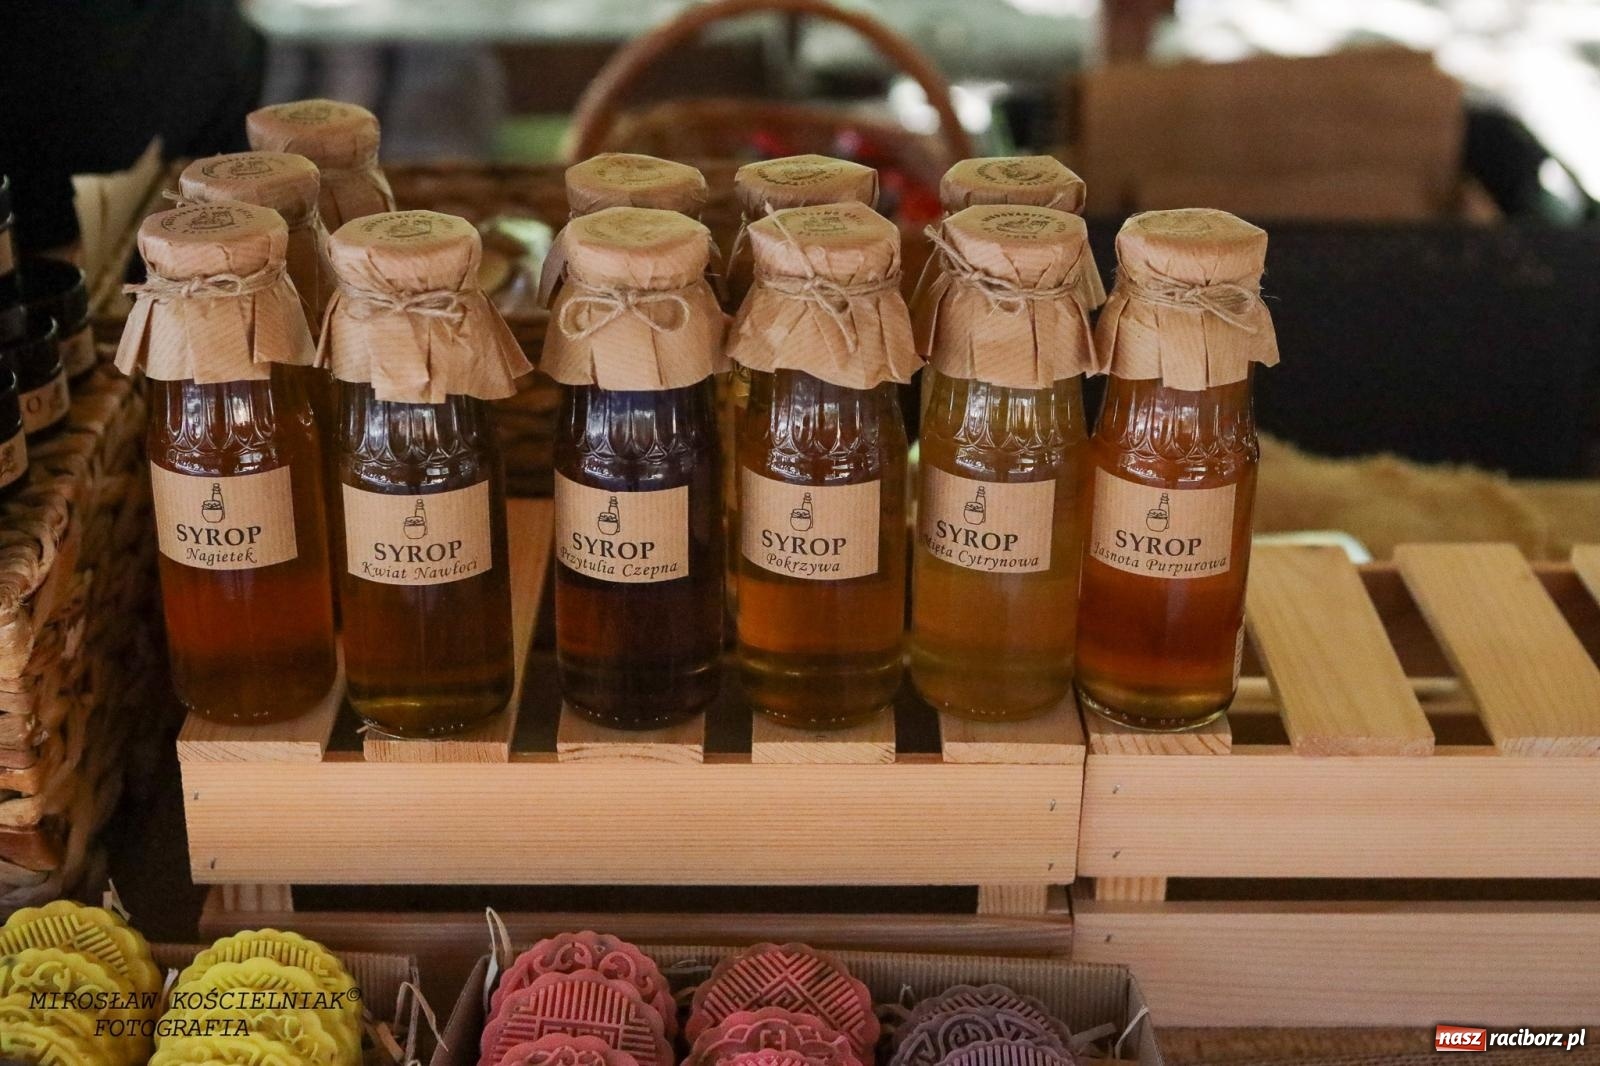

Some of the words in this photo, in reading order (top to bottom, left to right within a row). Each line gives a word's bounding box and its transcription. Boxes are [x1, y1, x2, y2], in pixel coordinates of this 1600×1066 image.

[176, 523, 262, 546] SYROP
[572, 531, 656, 560] SYROP
[761, 529, 847, 556] SYROP
[936, 519, 1019, 551] SYROP
[1115, 529, 1202, 557] SYROP
[186, 547, 258, 566] Nagietek
[374, 540, 463, 563] SYROP
[560, 546, 615, 575] Przytulia
[622, 560, 679, 579] Czepna
[766, 552, 841, 576] Pokrzywa
[958, 550, 1040, 571] Cytrynowa
[1094, 541, 1139, 568] Jasnota
[1146, 556, 1227, 576] Purpurowa
[361, 561, 407, 579] Kwiat
[413, 556, 479, 580] Nawłoci
